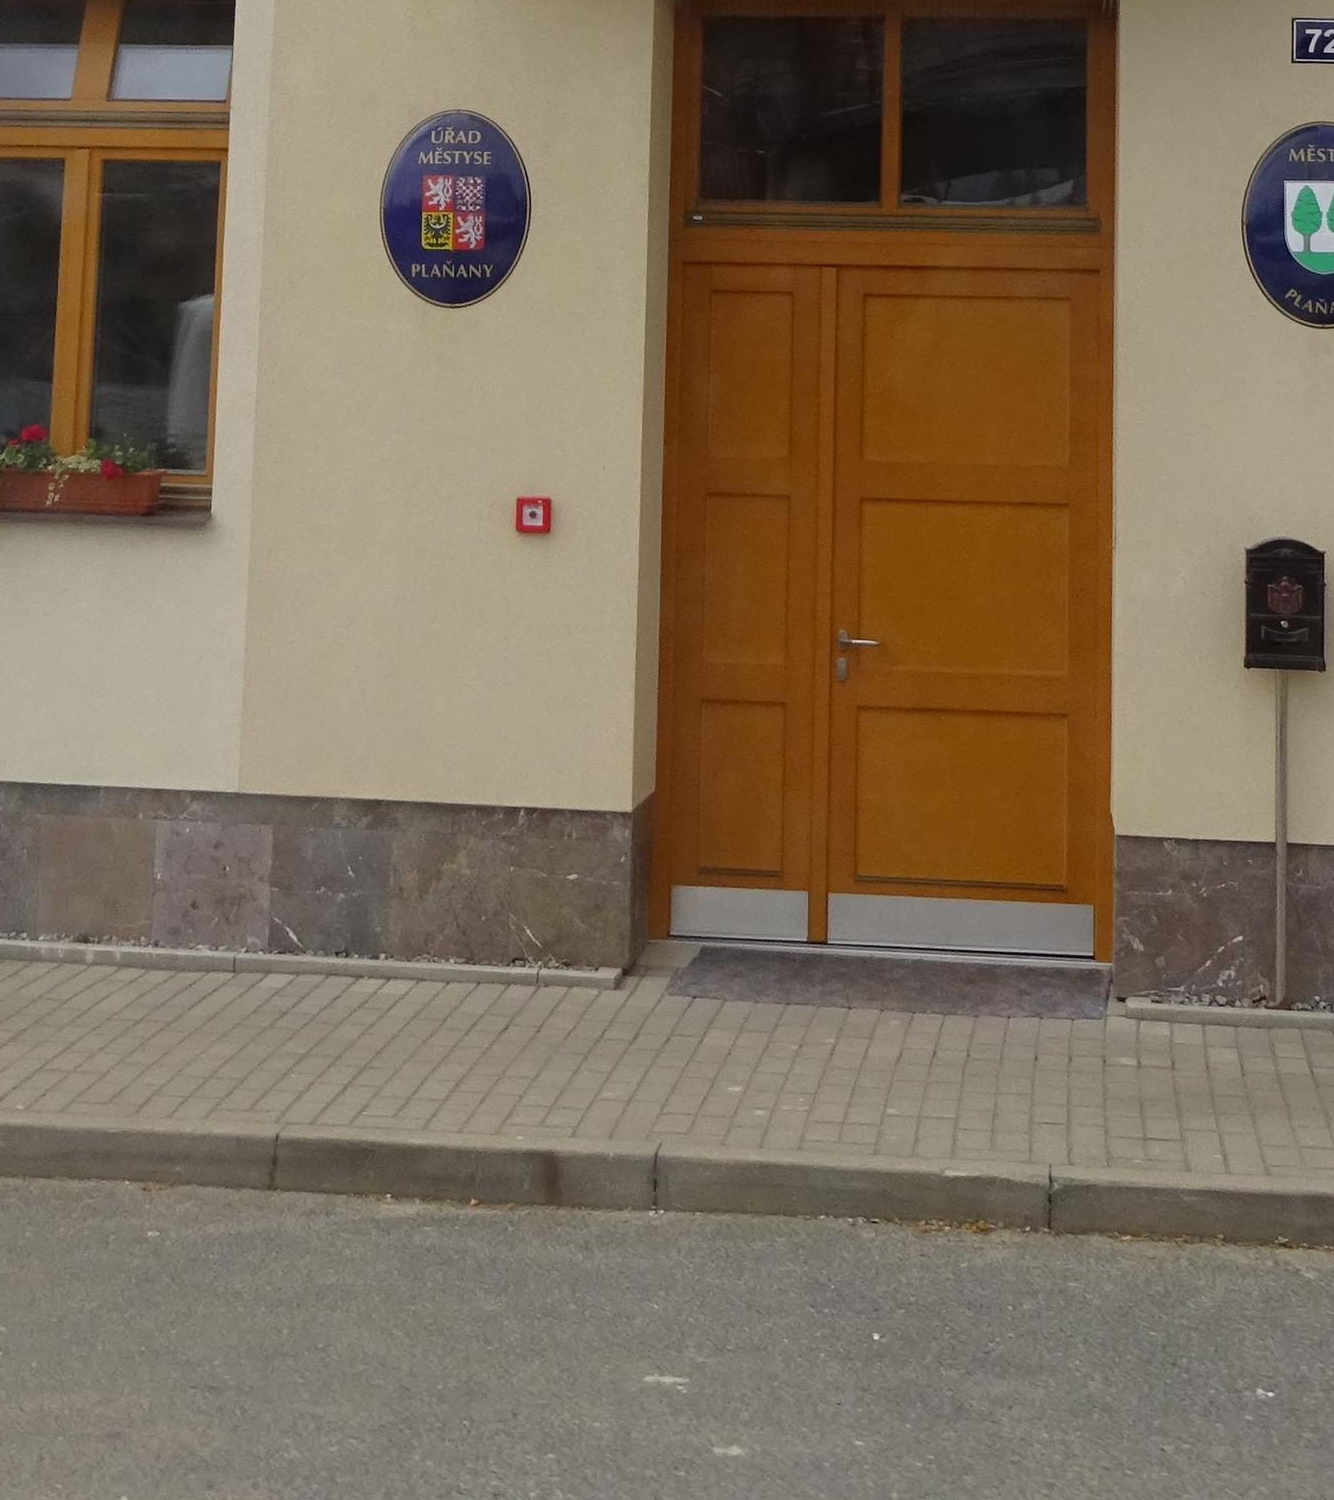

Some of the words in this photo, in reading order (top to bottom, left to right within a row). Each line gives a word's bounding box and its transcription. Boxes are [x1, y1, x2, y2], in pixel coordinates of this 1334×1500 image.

[430, 126, 482, 144] ÚŘAD
[418, 147, 492, 165] MĚSTYSE
[411, 260, 494, 278] PLAŇANY
